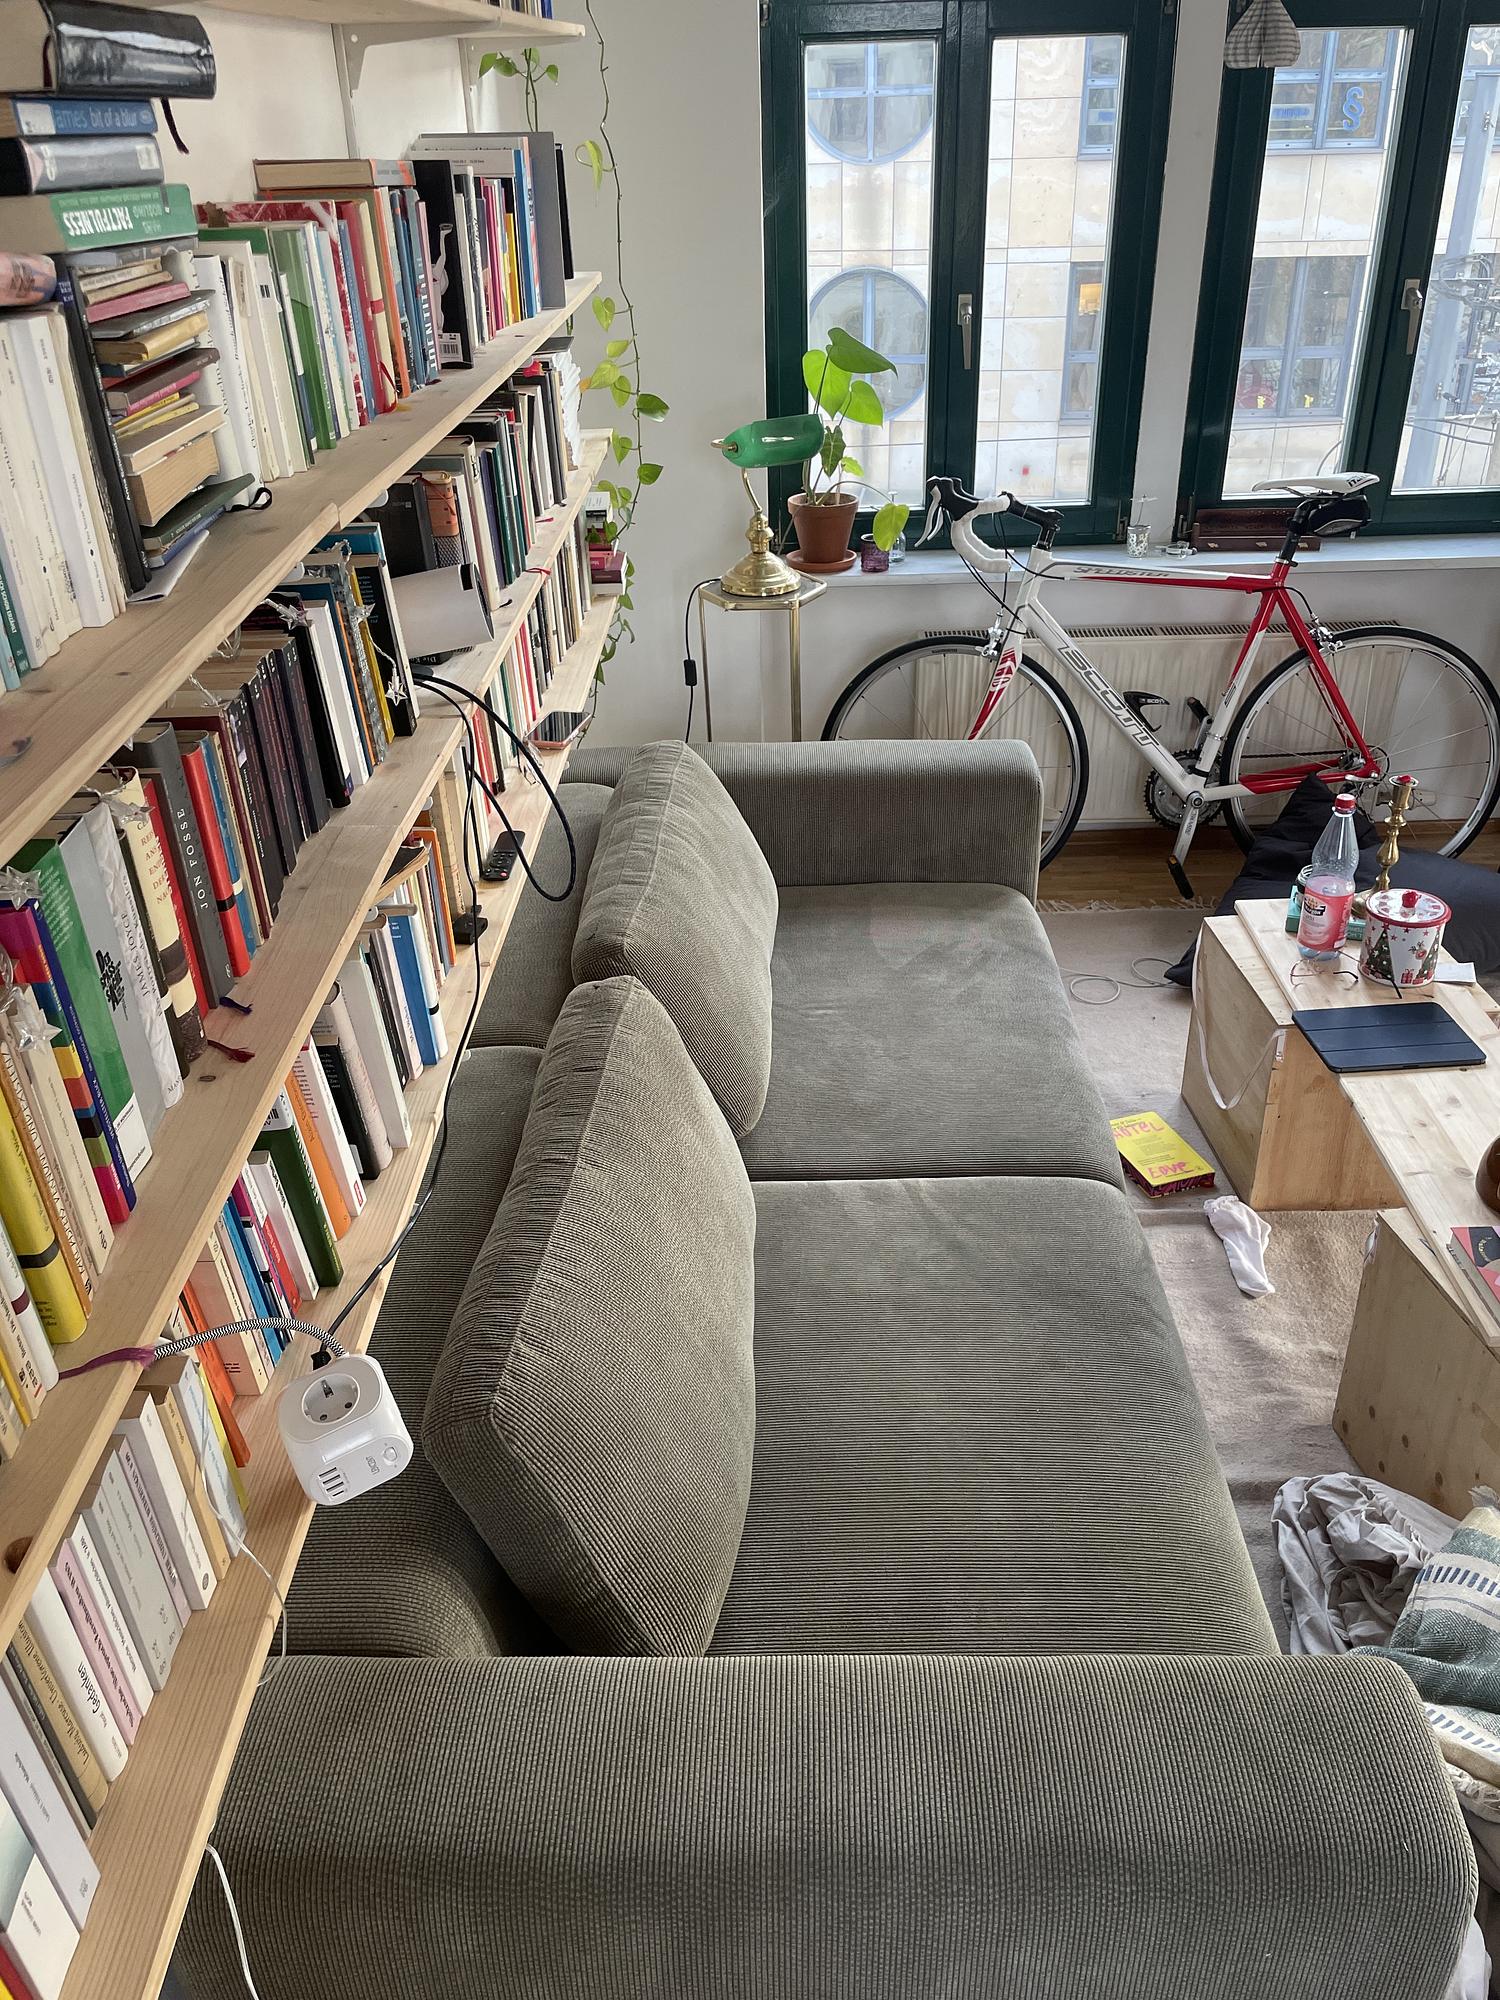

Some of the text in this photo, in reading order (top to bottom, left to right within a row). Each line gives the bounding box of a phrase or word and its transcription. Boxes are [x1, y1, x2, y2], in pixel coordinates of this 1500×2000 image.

[62, 199, 133, 241] FACTFULNESS
[1058, 646, 1160, 746] SCOTT
[173, 807, 210, 910] JON FOSSE
[118, 912, 150, 997] JAMES JOYCE
[0, 1050, 29, 1112] EXISTENZ
[23, 1113, 40, 1142] UND
[34, 1144, 61, 1202] VERNUNFT
[70, 1660, 104, 1713] Gedanken
[54, 1700, 77, 1737] Marcuse
[68, 1729, 92, 1765] Ludwig
